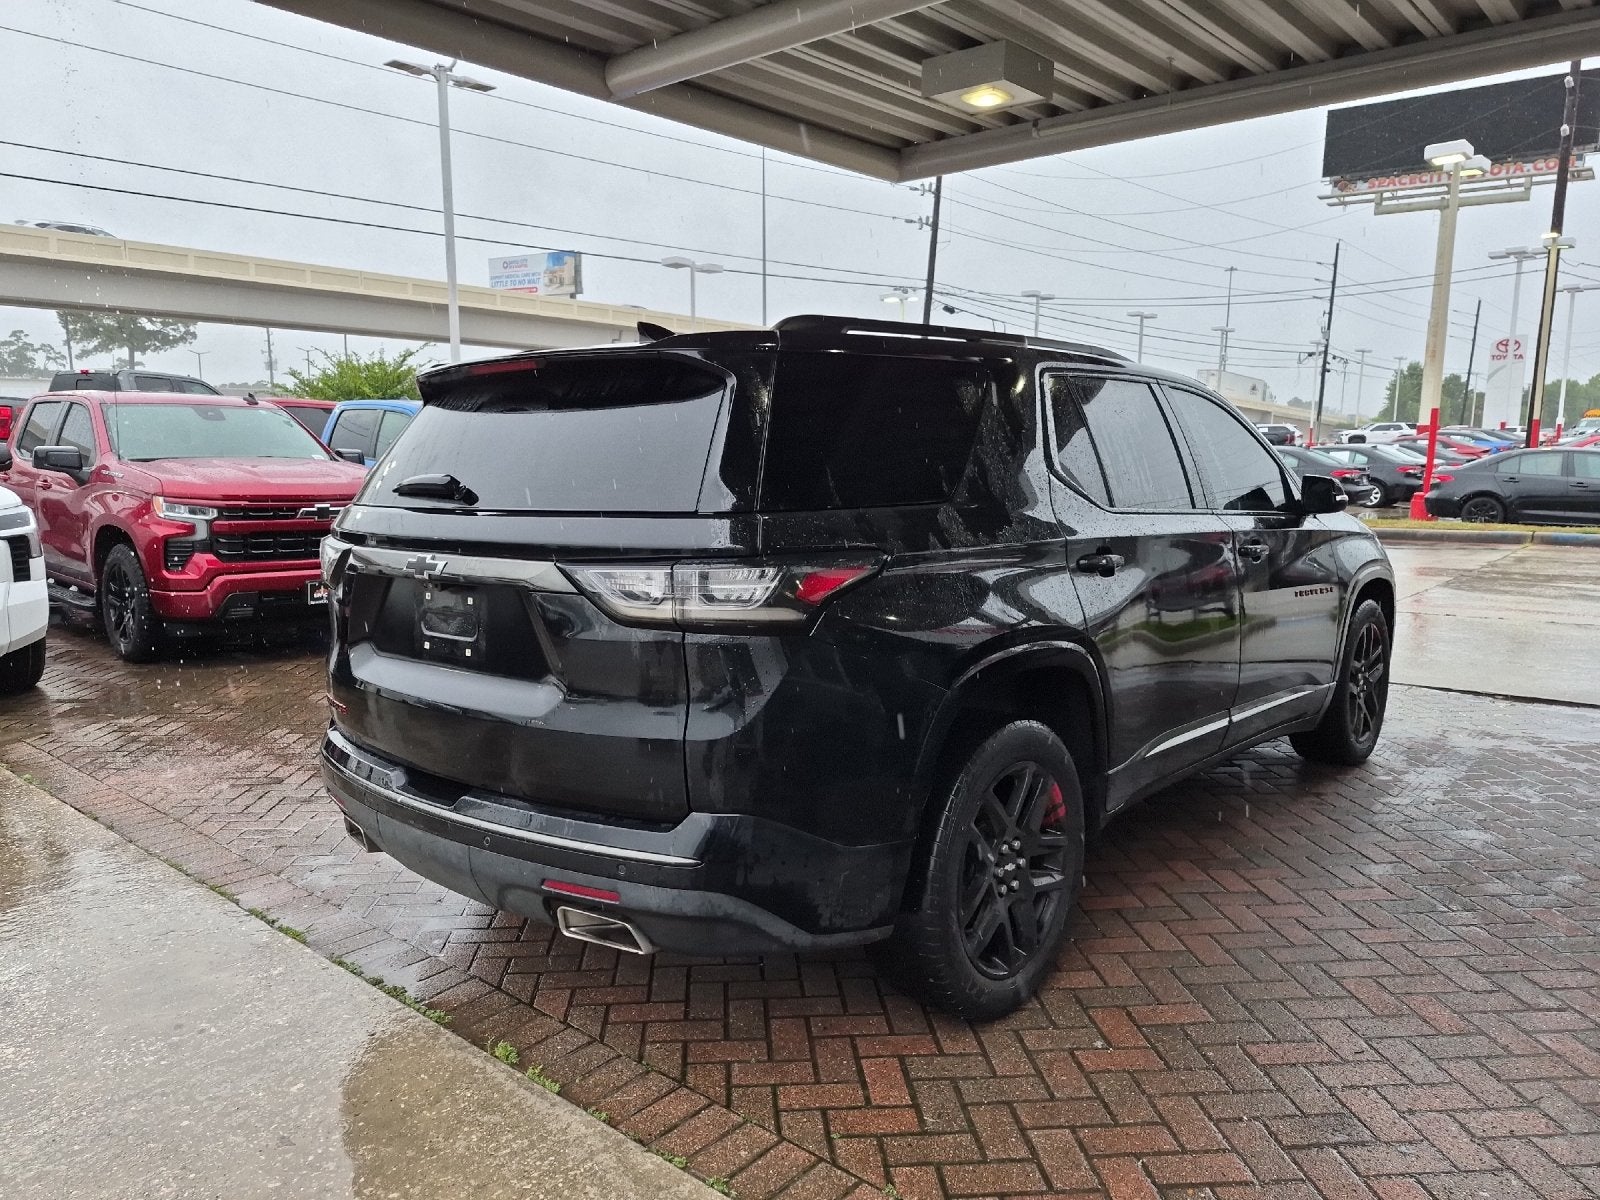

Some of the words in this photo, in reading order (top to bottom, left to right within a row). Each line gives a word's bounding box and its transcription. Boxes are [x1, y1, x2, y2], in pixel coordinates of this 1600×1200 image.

[491, 280, 509, 288] LITTLE
[510, 279, 518, 287] TO
[518, 278, 527, 286] NO
[527, 277, 541, 286] WAIT
[1491, 353, 1524, 361] TOYTA
